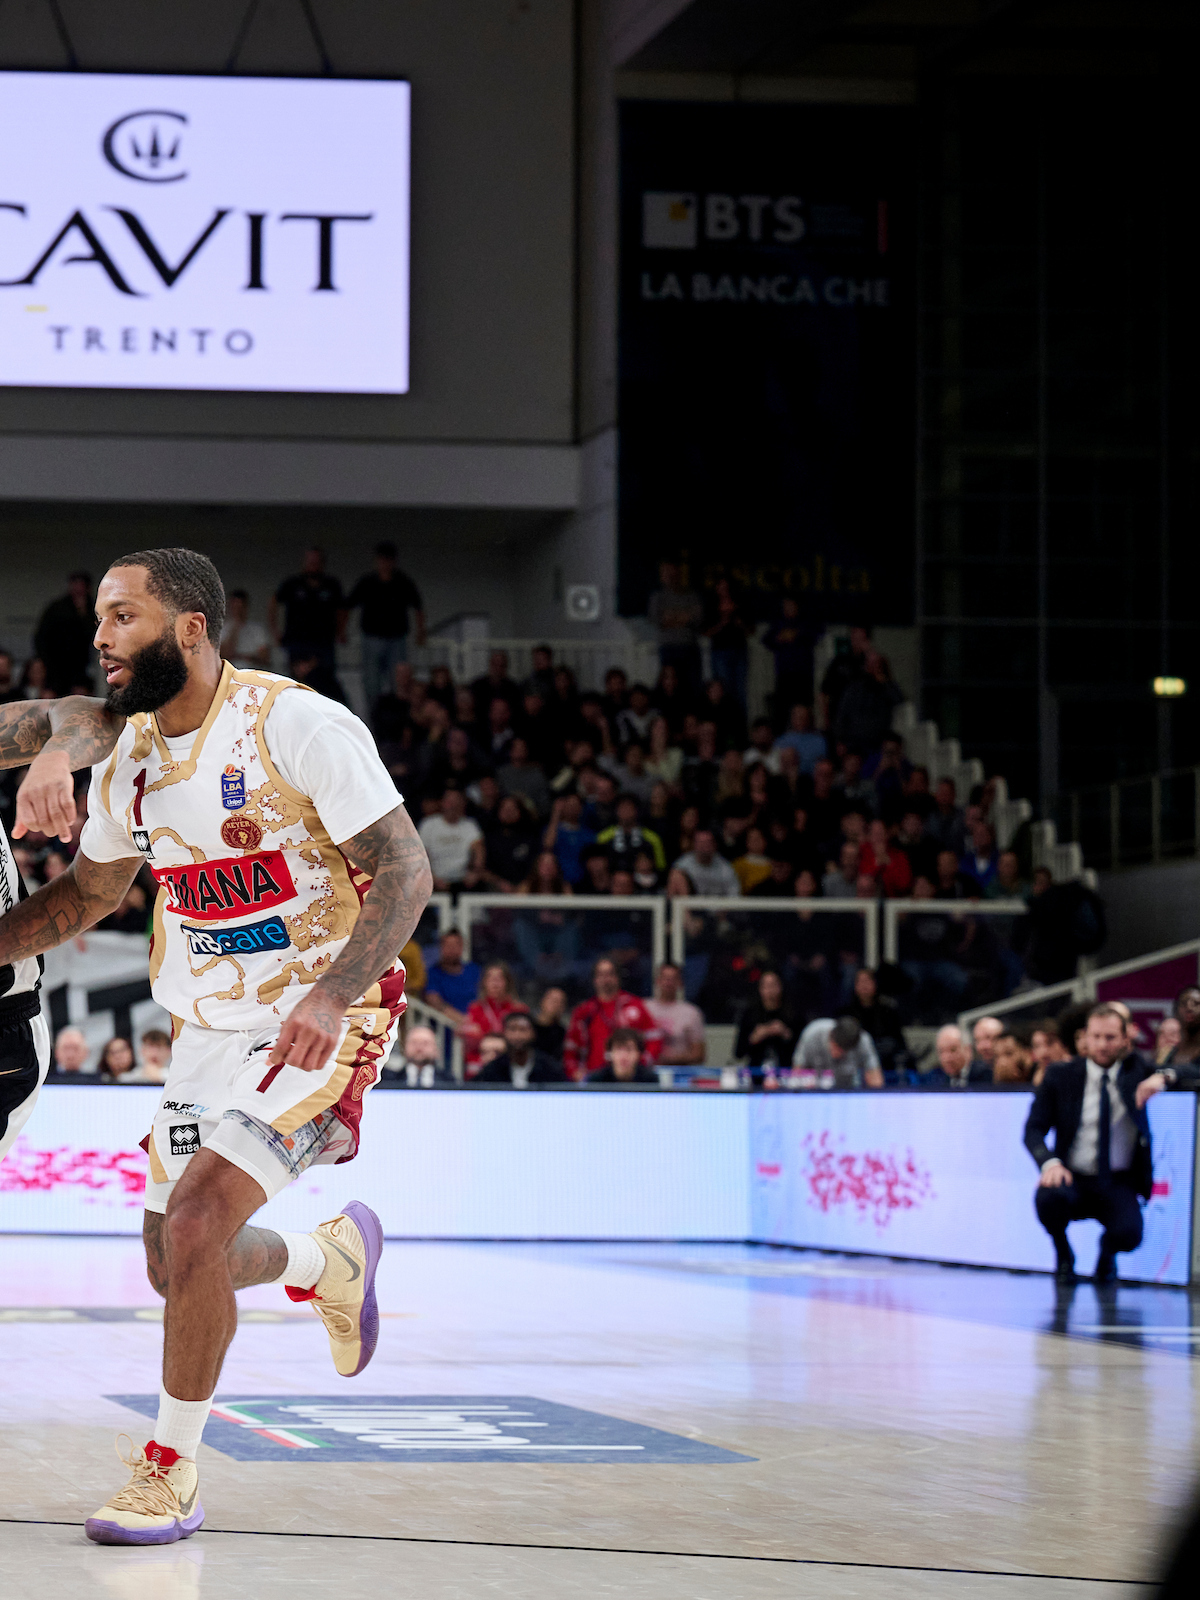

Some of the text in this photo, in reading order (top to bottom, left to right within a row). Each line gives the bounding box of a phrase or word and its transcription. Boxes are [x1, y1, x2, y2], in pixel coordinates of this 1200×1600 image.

[704, 192, 806, 242] BTS
[640, 272, 891, 308] LA BANCA CHE
[49, 326, 255, 355] TRENTO
[133, 768, 146, 827] 1
[224, 782, 243, 793] LBA
[225, 798, 243, 807] Unipol
[225, 820, 251, 829] REYER
